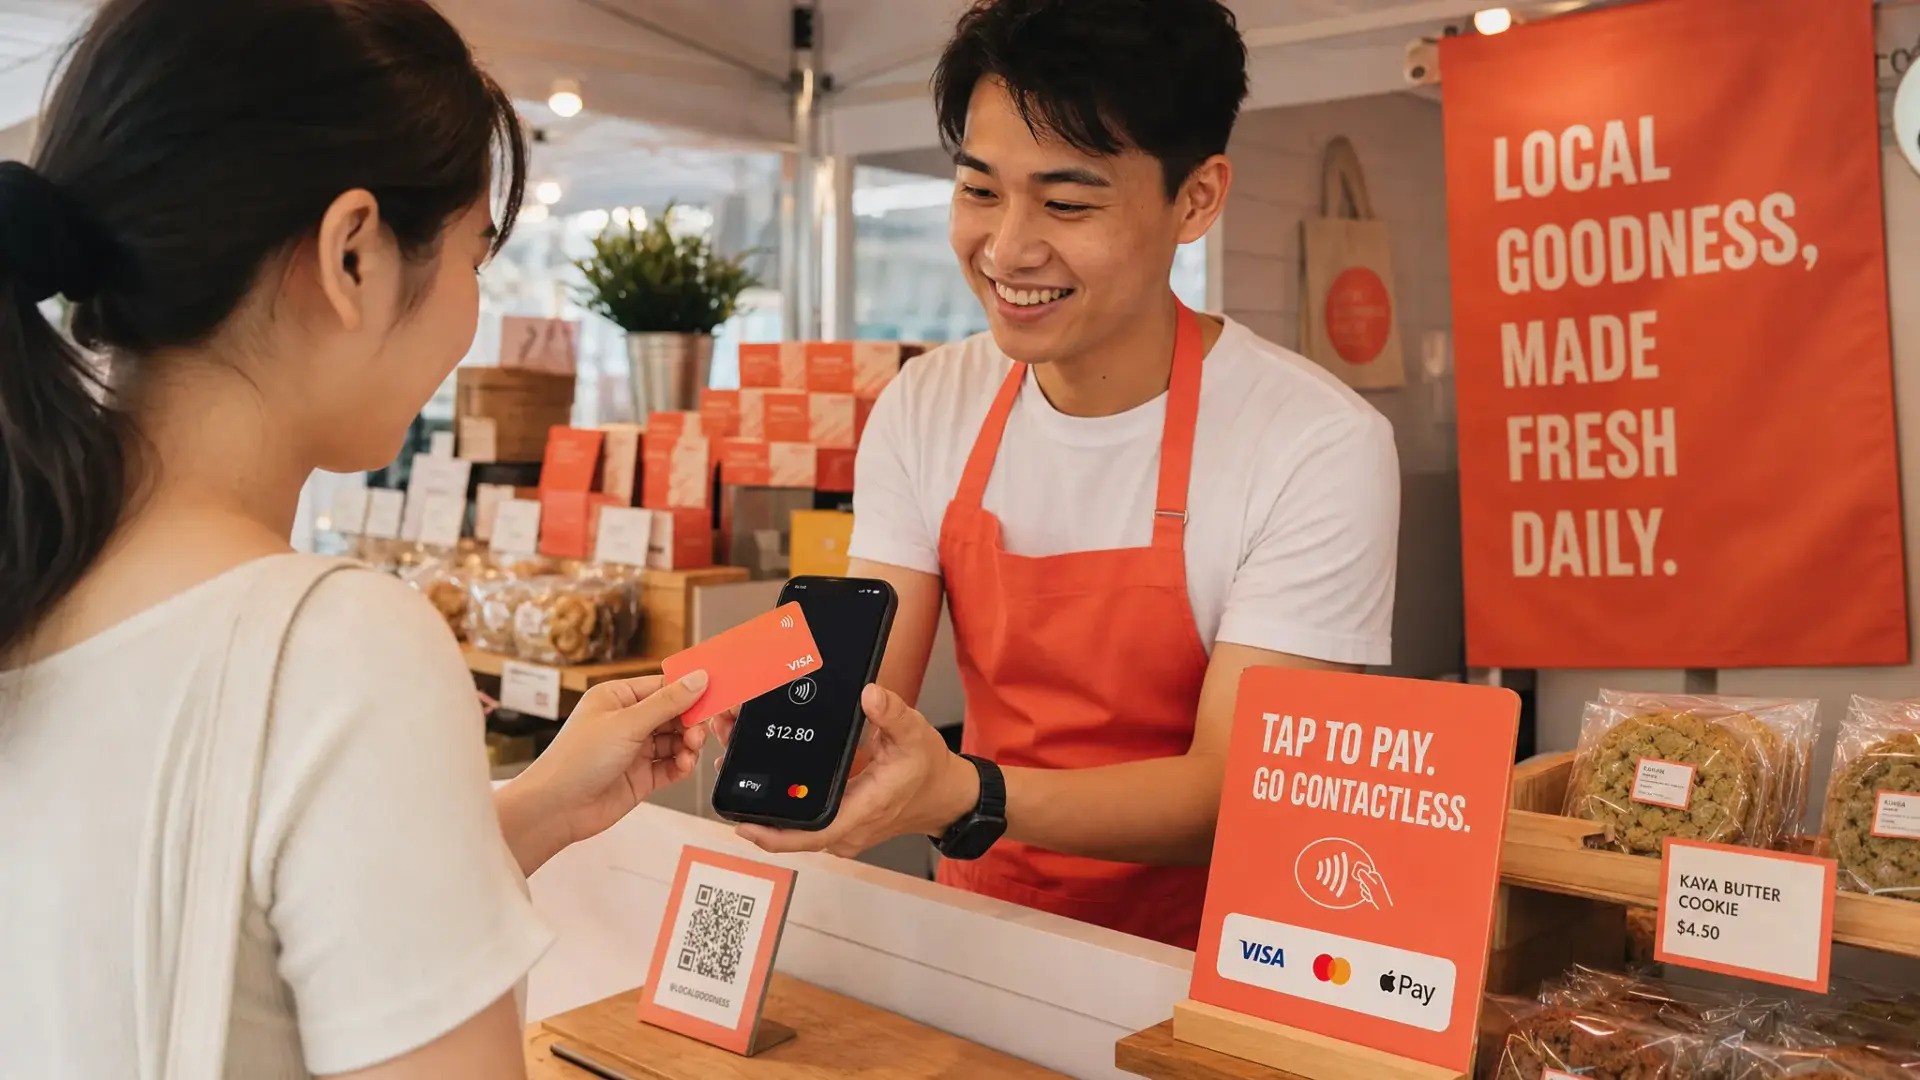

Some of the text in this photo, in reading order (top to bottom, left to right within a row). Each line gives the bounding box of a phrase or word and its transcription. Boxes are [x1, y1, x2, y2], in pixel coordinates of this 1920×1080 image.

[1494, 115, 1670, 201] LOCAL
[1495, 192, 1819, 295] GOODNESS,
[1501, 310, 1659, 388] MADE
[1508, 407, 1677, 482] FRESH
[1512, 508, 1678, 577] DAILY.
[785, 654, 814, 671] VISA
[765, 723, 815, 743] $12.80
[1261, 712, 1435, 775] TAP TO PAY.
[745, 779, 762, 791] Pay
[1252, 766, 1471, 832] GO CONTACTLESS.
[1679, 874, 1782, 904] KAYA BUTTER
[1678, 894, 1739, 918] COOKIE
[1676, 919, 1721, 941] $4.50
[1238, 938, 1285, 969] VISA
[1397, 974, 1436, 1007] Pay
